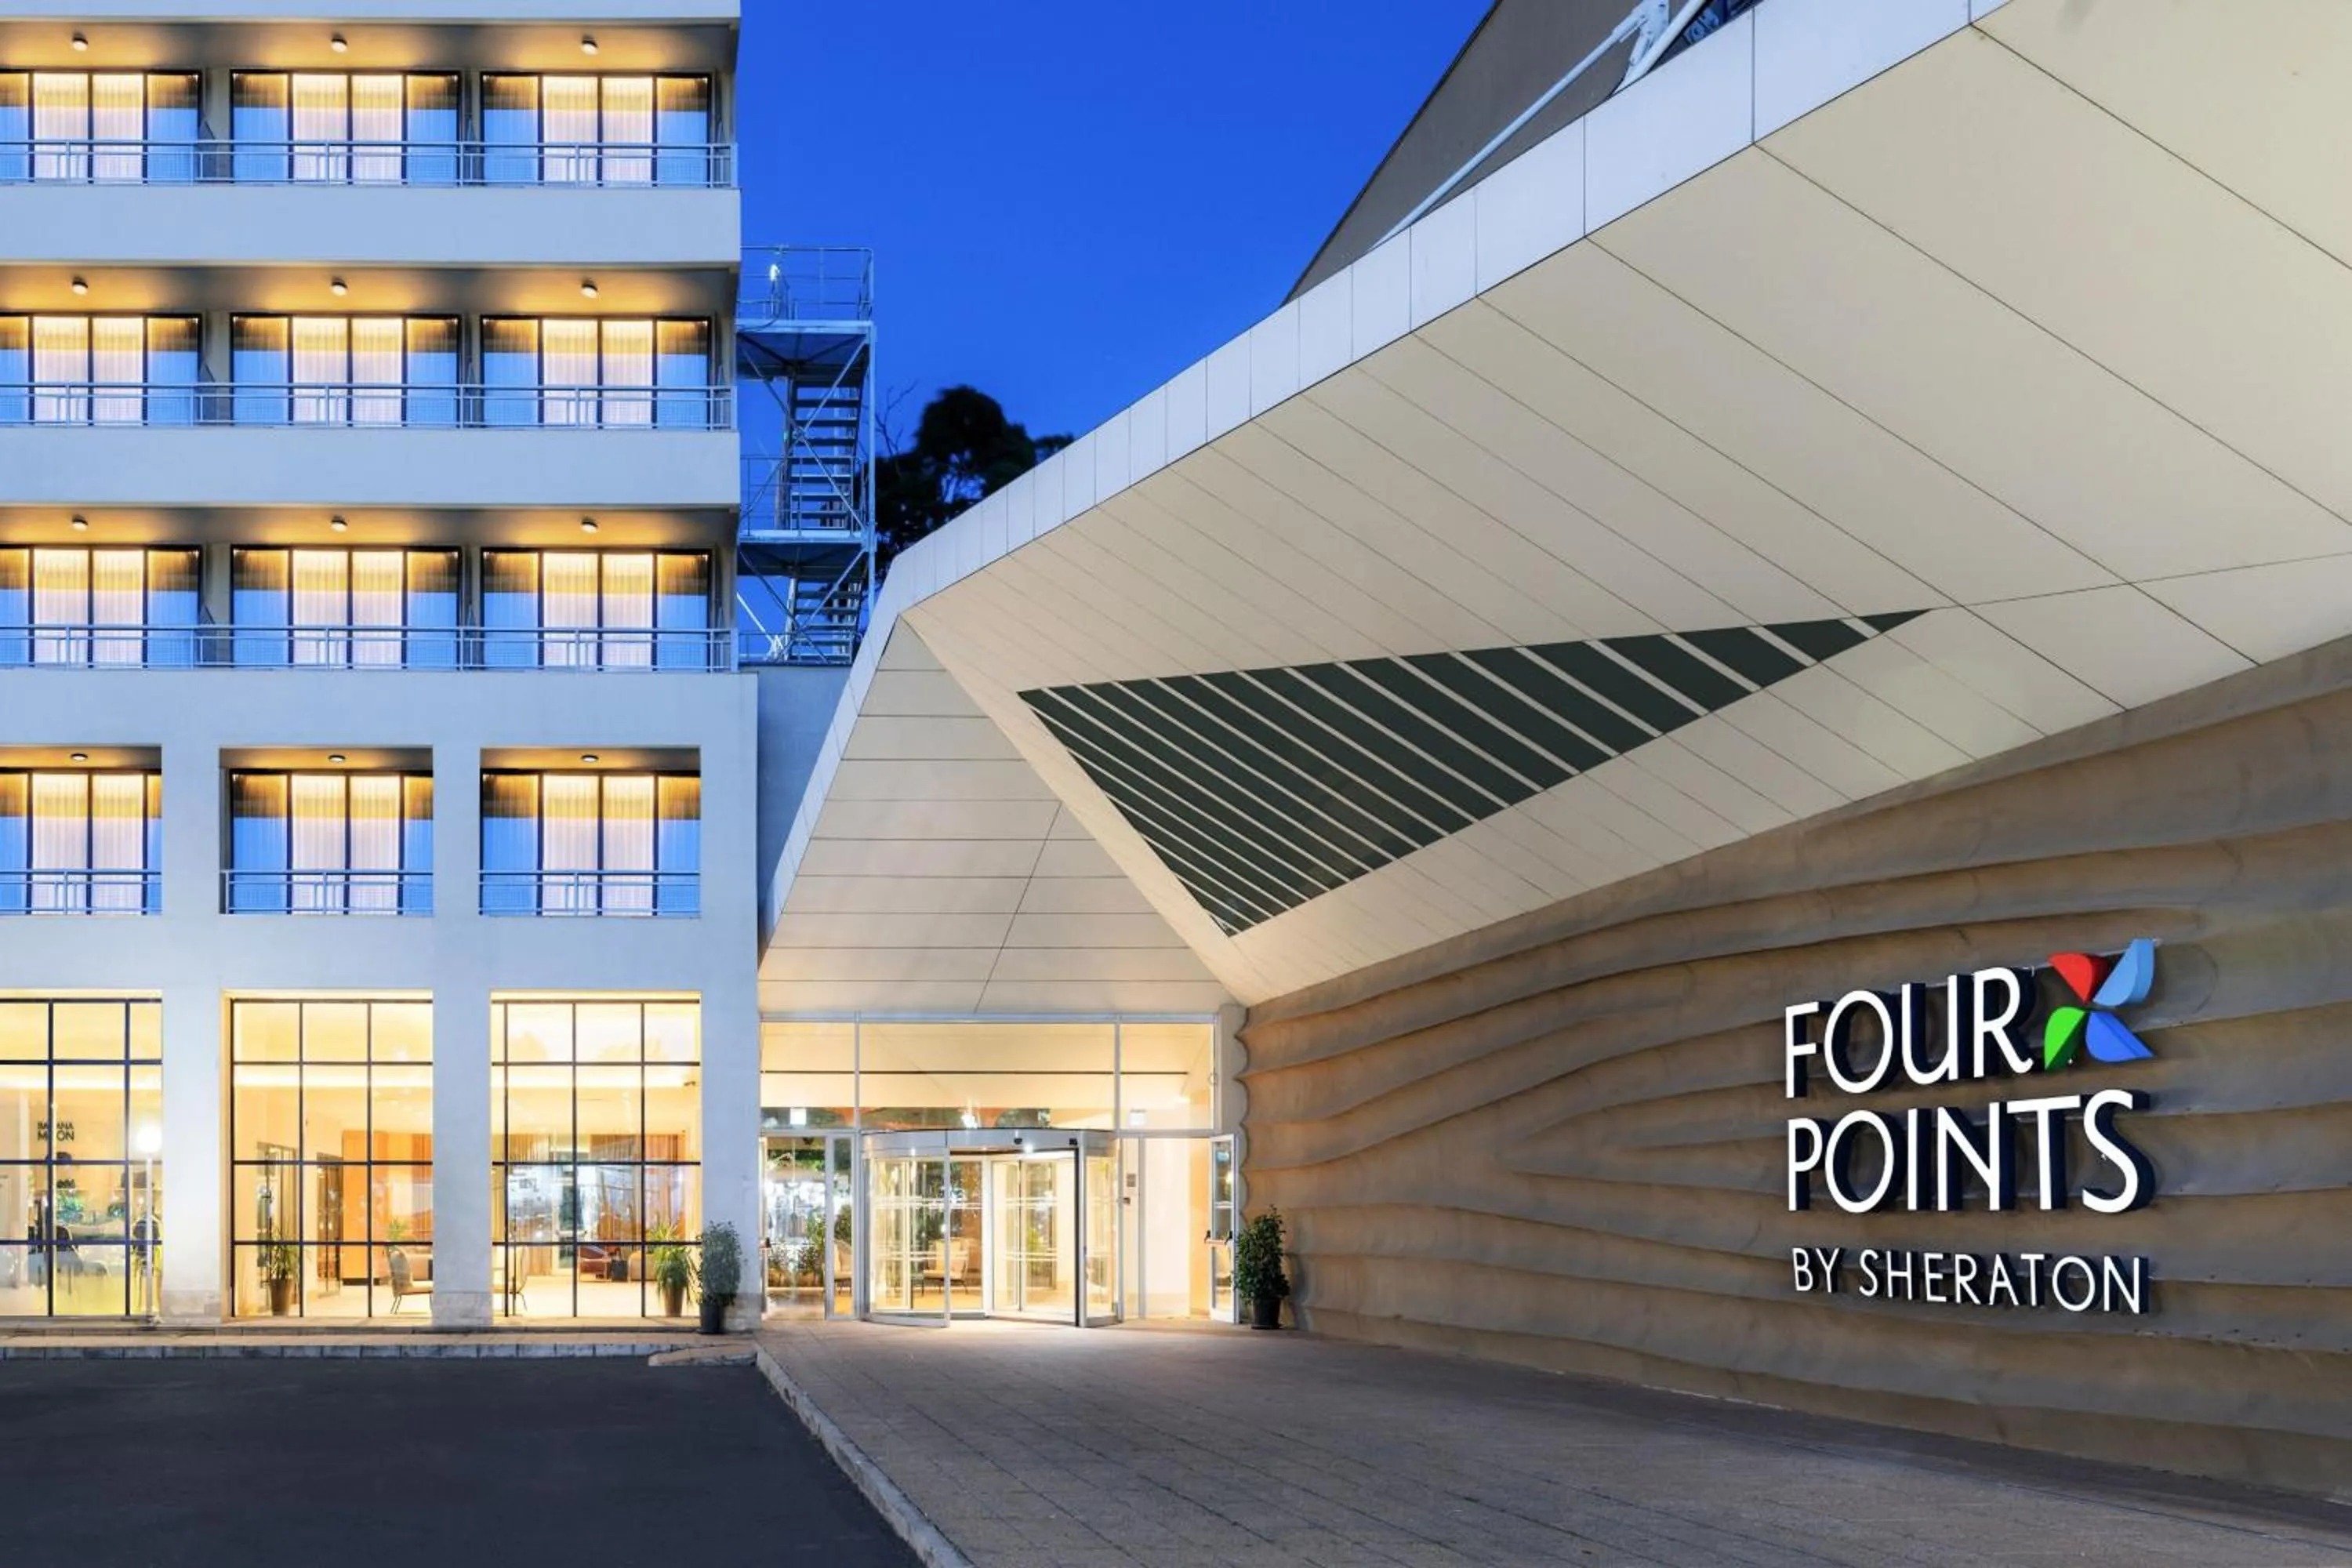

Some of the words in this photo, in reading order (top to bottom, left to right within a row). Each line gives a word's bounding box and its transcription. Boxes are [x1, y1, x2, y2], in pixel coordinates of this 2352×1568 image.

[1785, 967, 2034, 1098] FOUR
[37, 1130, 74, 1142] MON
[1788, 1089, 2139, 1213] POINTS
[1792, 1247, 1839, 1293] BY
[1859, 1249, 2140, 1314] SHERATON
